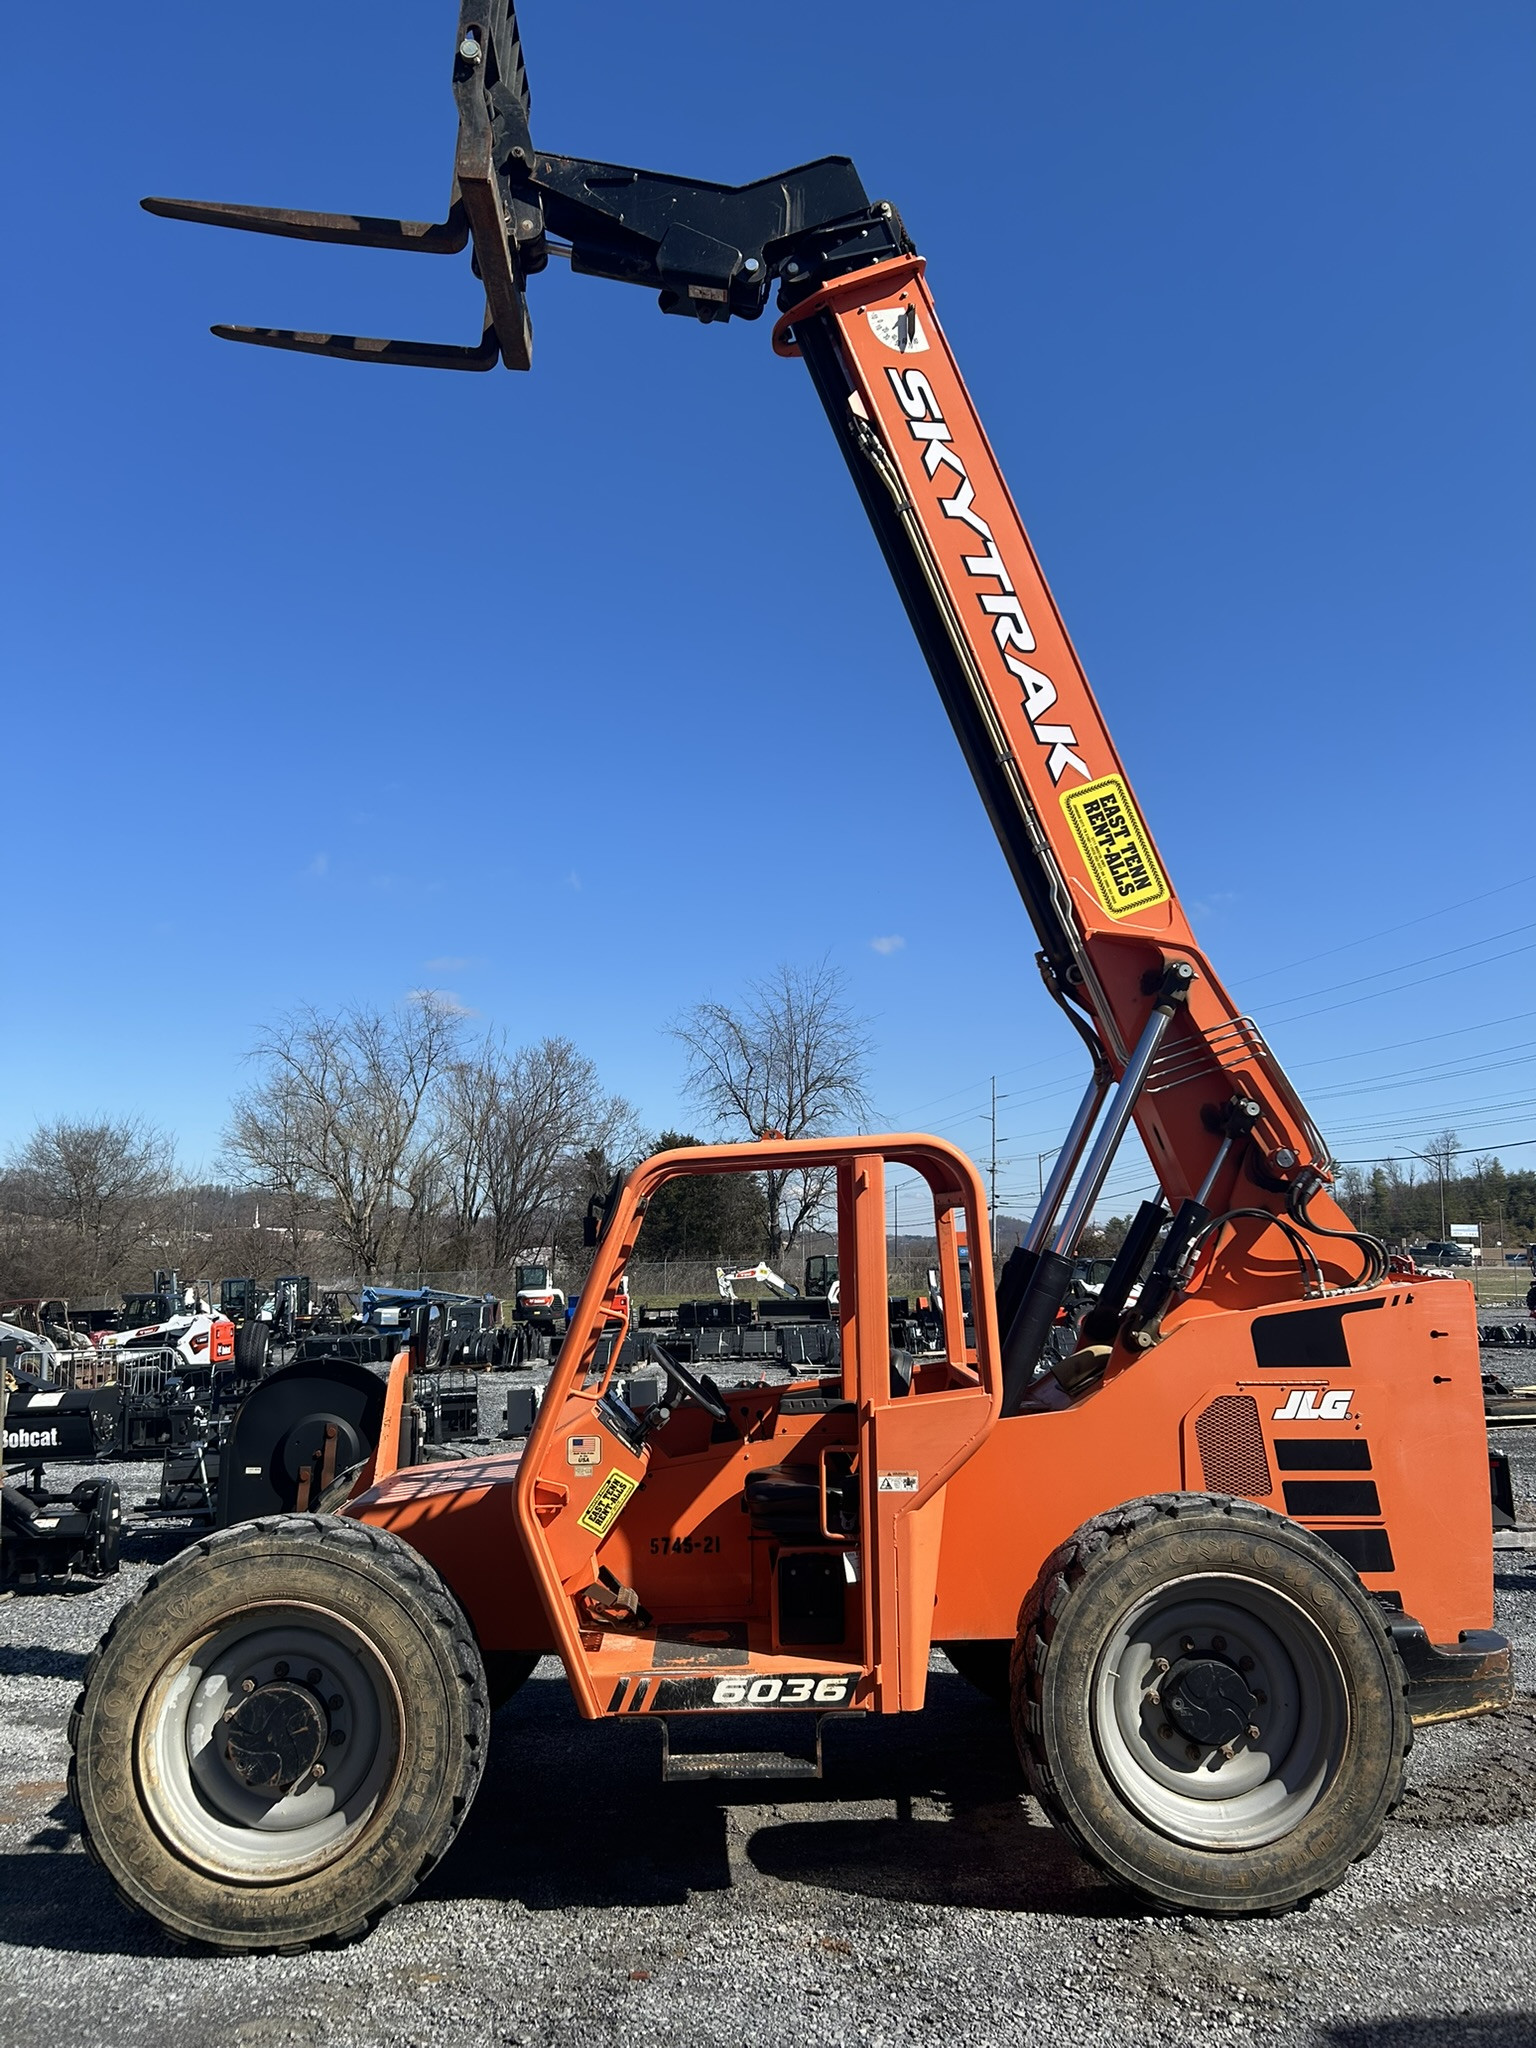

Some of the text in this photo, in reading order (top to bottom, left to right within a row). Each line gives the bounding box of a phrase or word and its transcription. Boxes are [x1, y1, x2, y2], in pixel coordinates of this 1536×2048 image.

[884, 366, 1092, 787] SKYTRAK
[1083, 799, 1135, 898] RENT-ALLS
[1099, 793, 1152, 891] EAST TENN
[1272, 1390, 1353, 1420] JLG
[2, 1428, 58, 1448] Bobcat
[588, 1500, 605, 1523] EAST
[603, 1478, 620, 1500] TENN
[594, 1483, 627, 1526] RENT-ALLS
[650, 1537, 721, 1555] 5745-21
[1099, 1538, 1336, 1606] Firestone
[712, 1678, 849, 1704] 6036
[97, 1629, 170, 1891] Firestone
